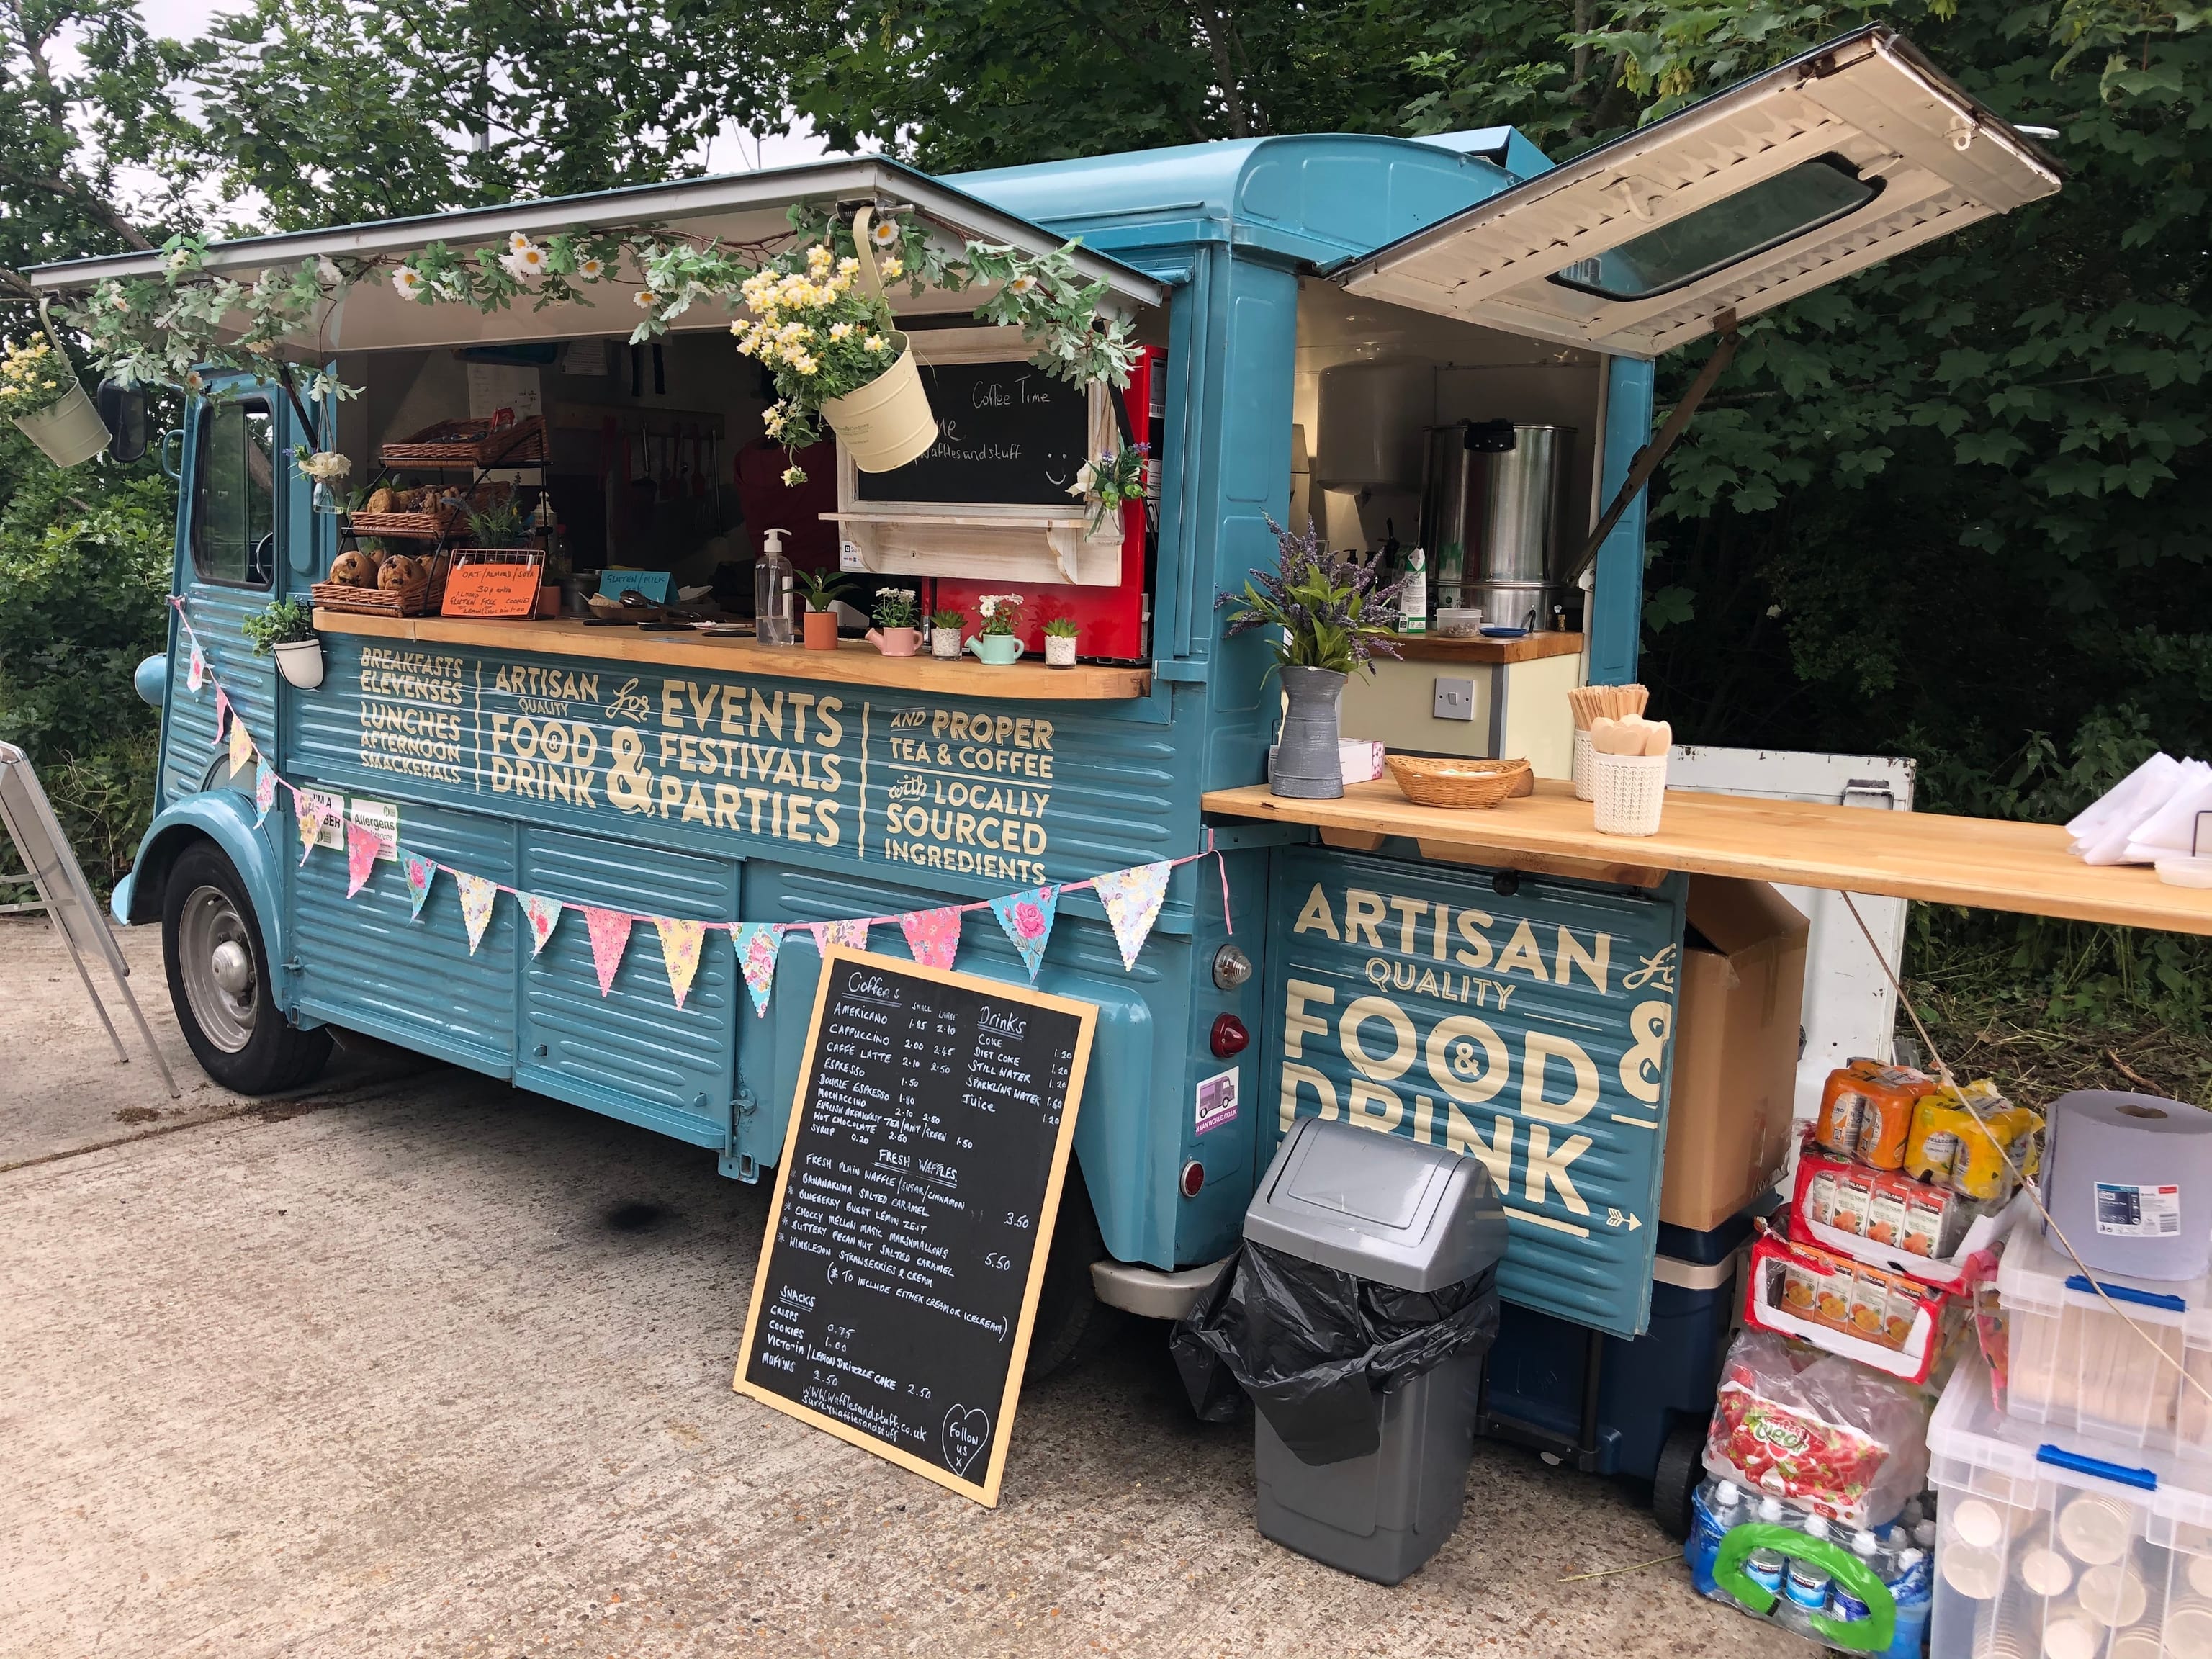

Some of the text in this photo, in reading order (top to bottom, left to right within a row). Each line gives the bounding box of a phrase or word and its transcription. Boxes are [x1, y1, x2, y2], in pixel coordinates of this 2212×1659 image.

[972, 380, 1011, 409] Coffee
[913, 443, 1022, 466] wafflesandstuff
[450, 596, 476, 605] GLUTEN
[361, 647, 464, 680] BREAKFASTS
[361, 669, 463, 704] ELEVENSES
[495, 664, 598, 703] ARTISAN
[361, 701, 461, 742] LUNCHES
[518, 698, 570, 717] QUALITY
[660, 679, 844, 748] EVENTS
[491, 714, 598, 768] FOOD
[890, 709, 1054, 752] AND PROPER
[361, 730, 461, 764] AFTERNOON
[660, 732, 843, 793] FESTIVALS
[889, 737, 1054, 779] TEA & COFFEE
[361, 751, 462, 785] SMACKERALS
[491, 756, 598, 809] DRINK
[606, 725, 656, 818] &
[326, 796, 332, 809] A
[660, 774, 841, 848] PARTIES
[889, 774, 1051, 819] with LOCALLY
[354, 814, 395, 832] Allergens
[886, 803, 1048, 857] SOURCED
[885, 837, 1046, 886] INGREDIENTS
[1293, 882, 1611, 994] ARTISAN
[1364, 956, 1516, 1011] QUALITY
[834, 1002, 888, 1025] AMERICANO
[830, 1024, 890, 1046] CAPPUCCINO
[978, 1033, 1003, 1048] COKE
[1283, 977, 1600, 1125] FOOD
[824, 1057, 865, 1077] ESPRESSO
[860, 1050, 892, 1063] LATTE
[968, 1059, 996, 1075] STILL
[999, 1066, 1031, 1084] WATER
[974, 1046, 994, 1060] DIET
[997, 1053, 1020, 1066] COKE
[818, 1073, 849, 1090] DOUBLE
[853, 1082, 889, 1101] ESPRESSO
[818, 1088, 866, 1108] MOCHACCINO
[966, 1075, 1012, 1097] SPARKLING
[1014, 1088, 1041, 1107] WATER
[814, 1112, 830, 1122] HOT
[832, 1115, 877, 1134] CHOCOLATE
[816, 1100, 843, 1115] ENGLISH
[810, 1123, 835, 1136] SYRUP
[806, 1153, 832, 1170] FRESH
[838, 1161, 860, 1177] PLAIN
[878, 1148, 911, 1168] FRESH
[799, 1189, 927, 1235] BLUEBERRY BURST LEMON ZEST
[858, 1188, 887, 1205] SALTED
[891, 1198, 930, 1218] CARAMEL
[795, 1206, 823, 1223] CHOCCY
[860, 1223, 883, 1238] MAGIC
[791, 1220, 827, 1237] BUTTERY
[832, 1230, 855, 1246] PECAN
[857, 1239, 874, 1251] NUT
[879, 1244, 911, 1263] SALTED
[916, 1257, 955, 1277] CARAMEL
[838, 1250, 896, 1275] STRAWBERRIES
[907, 1271, 933, 1288] CREAM
[780, 1285, 817, 1308] SNACKS
[858, 1277, 891, 1295] INCLUDE
[896, 1288, 924, 1305] EITHER
[926, 1298, 950, 1314] CREAM
[950, 1308, 961, 1318] OR
[769, 1319, 804, 1339] COOKIES
[770, 1305, 799, 1323] CRISPS
[837, 1359, 874, 1380] DRIZZLE
[874, 1375, 897, 1390] CAKE
